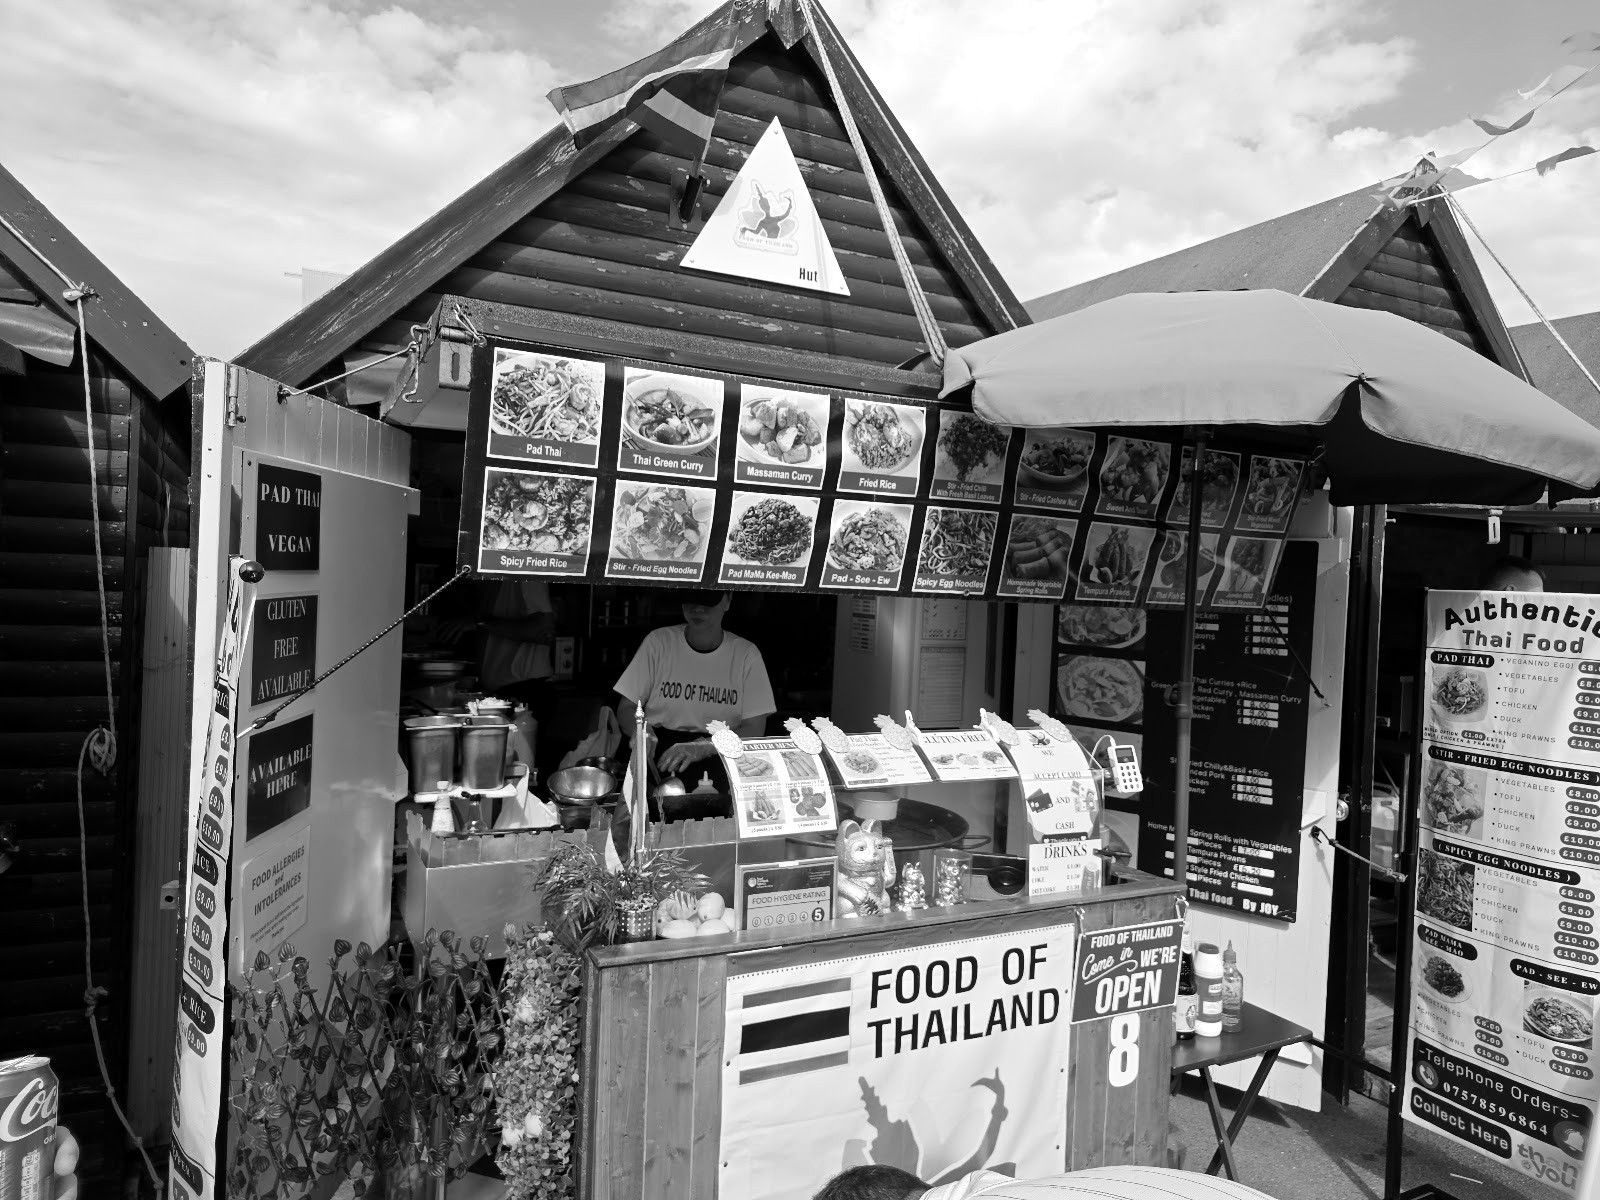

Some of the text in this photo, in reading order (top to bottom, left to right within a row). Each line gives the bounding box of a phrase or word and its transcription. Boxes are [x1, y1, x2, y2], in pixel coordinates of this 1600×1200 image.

[799, 268, 818, 282] Hut
[526, 444, 562, 457] Pad Thai
[632, 454, 704, 473] Thai Green Curry
[746, 466, 814, 483] Massaman Curry
[858, 477, 897, 490] Fried Rice
[261, 482, 320, 508] PAD THAI
[268, 534, 312, 553] VEGAN
[500, 555, 567, 568] Spicy Fried Rice
[613, 562, 698, 575] Stir Fried Egg Noodles
[728, 569, 797, 580] Pad MaMa Kee-Mao
[831, 574, 848, 583] Pad
[877, 575, 890, 584] Ew
[916, 577, 984, 589] Spicy Egg Noodles
[1084, 586, 1130, 597] Tempura Prawns
[267, 598, 307, 621] GLUTEN
[274, 636, 299, 659] FREE
[1462, 630, 1585, 654] Thai Food
[1437, 654, 1491, 666] PAD THAI
[258, 669, 311, 701] AVAILABLE
[1192, 676, 1208, 685] Thai
[1208, 677, 1235, 687] Curries
[1504, 673, 1560, 684] VEGETABLES
[684, 684, 697, 700] OF
[698, 685, 738, 706] THAILAND
[1197, 686, 1211, 695] Red
[1213, 687, 1233, 696] Curry
[1239, 690, 1279, 701] Massaman
[1280, 694, 1303, 704] Curry
[1503, 686, 1526, 695] TOFU
[1501, 701, 1538, 711] CHICKEN
[1500, 715, 1522, 724] DUCK
[959, 733, 990, 743] FREE
[1498, 730, 1556, 743] KING PRAWNS
[249, 743, 312, 784] AVAILABLE
[1435, 749, 1590, 781] STIR FRIED EGG NOODLES
[1208, 770, 1225, 780] Pork
[266, 770, 297, 799] HERE
[1500, 777, 1556, 793] VEGETABLES
[1055, 796, 1071, 804] AND
[1500, 792, 1521, 802] TOFU
[1568, 790, 1599, 800] £8.00
[1498, 807, 1536, 820] CHICKEN
[1567, 804, 1598, 815] £9.00
[1055, 821, 1075, 830] CASH
[1497, 822, 1520, 832] DUCK
[1566, 819, 1597, 829] £9.00
[1147, 821, 1293, 854] Home Spring Rolls with Vegetables
[1563, 835, 1600, 847] £10.00
[1044, 844, 1088, 859] DRINKS
[1496, 837, 1557, 855] KING PRAWNS
[1188, 846, 1247, 864] Tempura Prawns
[1445, 845, 1561, 879] SPICY EGG NOODLES
[1562, 850, 1600, 861] £10.00
[251, 845, 306, 891] FOOD ALLERGIES
[1190, 864, 1260, 885] Style Fried Chicken
[274, 871, 285, 887] and
[1197, 875, 1222, 886] Pieces
[1482, 867, 1539, 887] VEGETABLES
[253, 871, 302, 916] INTOLERANCES
[1482, 882, 1505, 894] TOFU
[1560, 888, 1592, 900] £8.00
[752, 890, 826, 905] FOOD HYGIENE RATING
[1188, 887, 1280, 916] Thai food By JOY
[1481, 898, 1519, 914] CHICKEN
[1560, 904, 1591, 917] £9.00
[1480, 913, 1504, 924] DUCK
[1559, 920, 1590, 933] £9.00
[1091, 925, 1173, 949] FOOD OF THAILAND
[1480, 928, 1541, 952] KING PRAWNS
[1557, 934, 1596, 948] £10.00
[1120, 947, 1133, 961] in
[1556, 949, 1595, 963] £10.00
[1081, 945, 1178, 980] Come WE'RE
[870, 943, 1048, 1009] FOOD OF
[1516, 964, 1599, 991] PAD SEE EW
[1094, 969, 1163, 1014] OPEN
[189, 996, 207, 1025] RICE
[867, 987, 1060, 1059] THAILAND
[187, 1028, 205, 1053] £9.00
[1476, 1031, 1501, 1046] £9.00
[1522, 1036, 1546, 1050] TOFU
[1109, 1013, 1141, 1088] 8
[1522, 1051, 1546, 1065] DUCK
[1553, 1047, 1586, 1061] £9.00
[1551, 1061, 1589, 1078] £10.00
[1443, 1081, 1549, 1136] 07578596864
[1413, 1094, 1509, 1150] Collect Here
